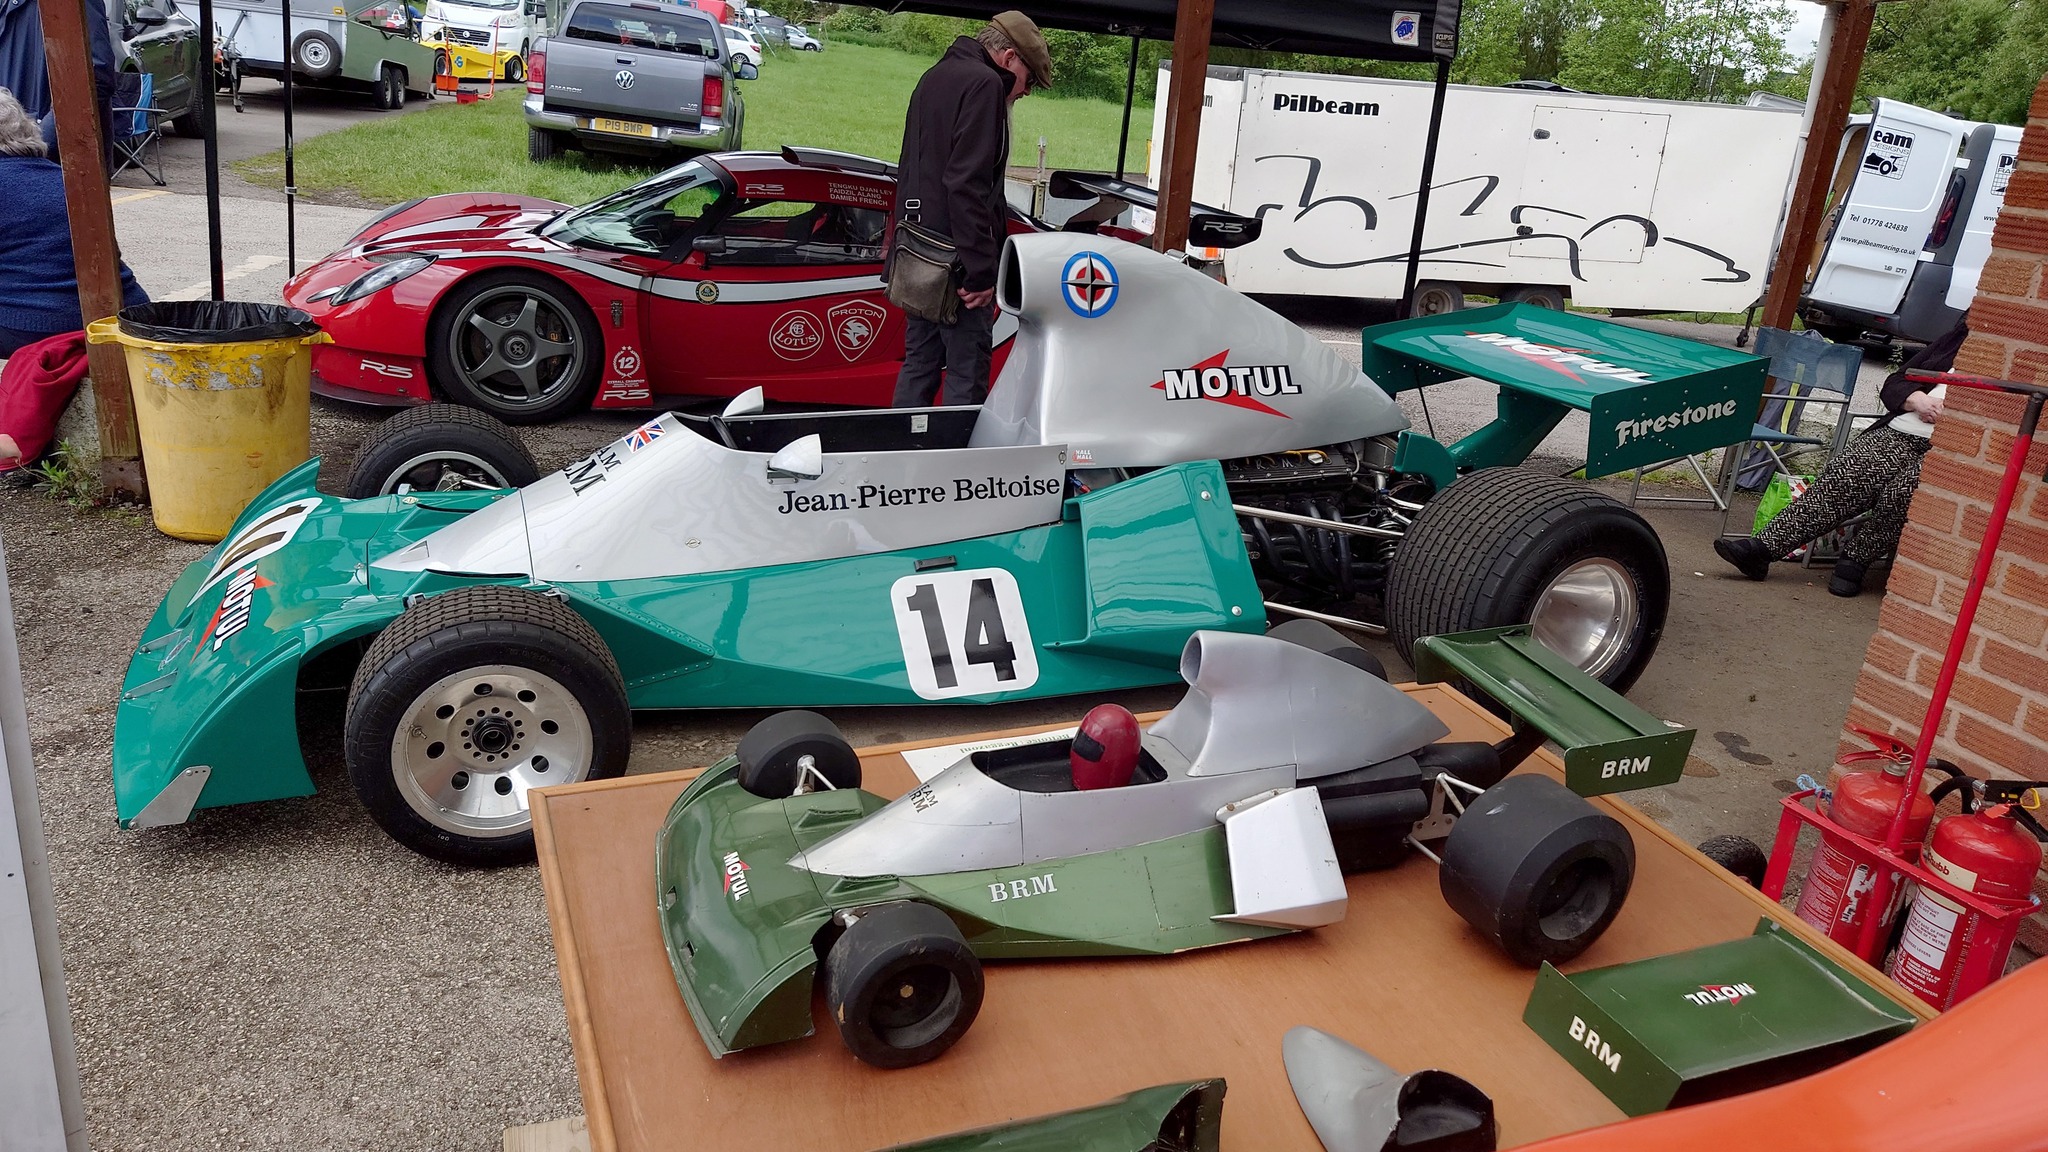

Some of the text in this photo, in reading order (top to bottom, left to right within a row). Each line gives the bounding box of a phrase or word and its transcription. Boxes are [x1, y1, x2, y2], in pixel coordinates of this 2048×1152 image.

[549, 84, 582, 94] AMAROK
[1272, 93, 1380, 116] Pilbeam
[604, 119, 643, 134] P19 BWR
[1869, 141, 1910, 155] DESIGNS
[828, 182, 858, 191] TENGKU
[859, 186, 878, 194] DJAN
[829, 187, 882, 200] FAIDZIL ALANG
[830, 193, 888, 206] DAMIEN FRENCH
[1849, 214, 1909, 233] Tel 01778 424838
[1840, 235, 1917, 256] www.pilbeamracing.co.uk
[831, 308, 883, 319] PROTON
[776, 331, 817, 347] LOTUS
[618, 356, 635, 369] 12
[1463, 332, 1658, 385] MOTUL
[1162, 364, 1303, 401] MOTUL
[1614, 398, 1738, 449] Firestone
[778, 474, 1061, 514] Jean-Pierre Beltoise
[212, 564, 259, 654] MOTUL
[906, 577, 1017, 690] 14
[1600, 755, 1651, 779] BRM
[909, 789, 930, 814] RM
[723, 850, 750, 902] MOTUL
[987, 873, 1057, 904] BRM
[1683, 982, 1757, 1006] MOTUL
[1568, 1015, 1623, 1074] BRM
